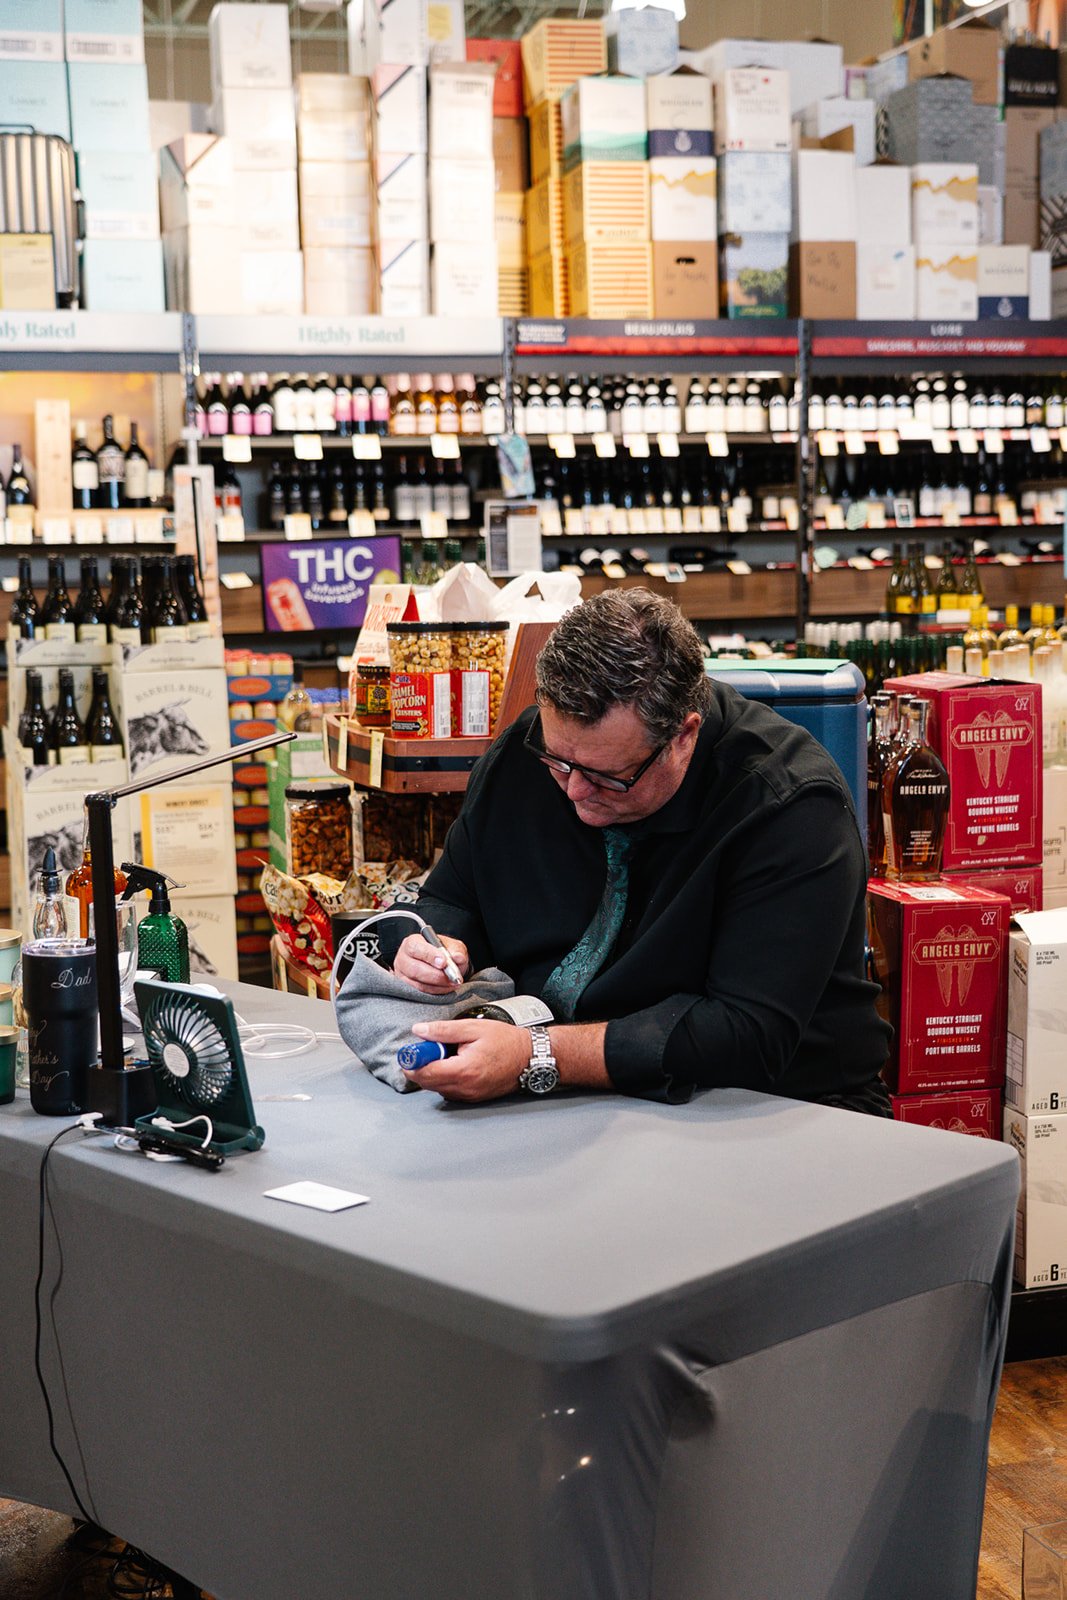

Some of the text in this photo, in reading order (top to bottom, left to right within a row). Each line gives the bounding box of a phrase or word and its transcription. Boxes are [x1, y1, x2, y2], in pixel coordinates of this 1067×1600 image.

[26, 322, 76, 338] Rated
[298, 326, 405, 345] Highly Rated
[624, 322, 696, 336] BEAUJOLAIS
[930, 324, 964, 337] LOIRE
[288, 545, 374, 583] THC
[304, 586, 365, 604] beverages
[960, 727, 1025, 743] ANGELS ENVY
[900, 785, 947, 795] ANGELS ENVY
[966, 794, 1020, 806] KENTUCKY STRAIGHT
[36, 802, 78, 820] BARREL
[968, 805, 1018, 816] BOURBON WHISKEY
[967, 823, 1020, 834] PORT WINE BARRELS
[343, 939, 381, 956] OBX
[922, 943, 991, 958] ANGELS ENVY
[50, 966, 93, 990] Dad
[926, 1014, 982, 1025] KENTUCKY STRAIGHT
[927, 1025, 981, 1036] BOURBON WHISKEY
[925, 1044, 981, 1055] PORT WINE BARRELS
[31, 1069, 70, 1092] Day
[1032, 1102, 1048, 1110] AGED
[1050, 1092, 1059, 1110] 6
[1033, 1274, 1048, 1282] AGED
[1050, 1264, 1059, 1281] 6
